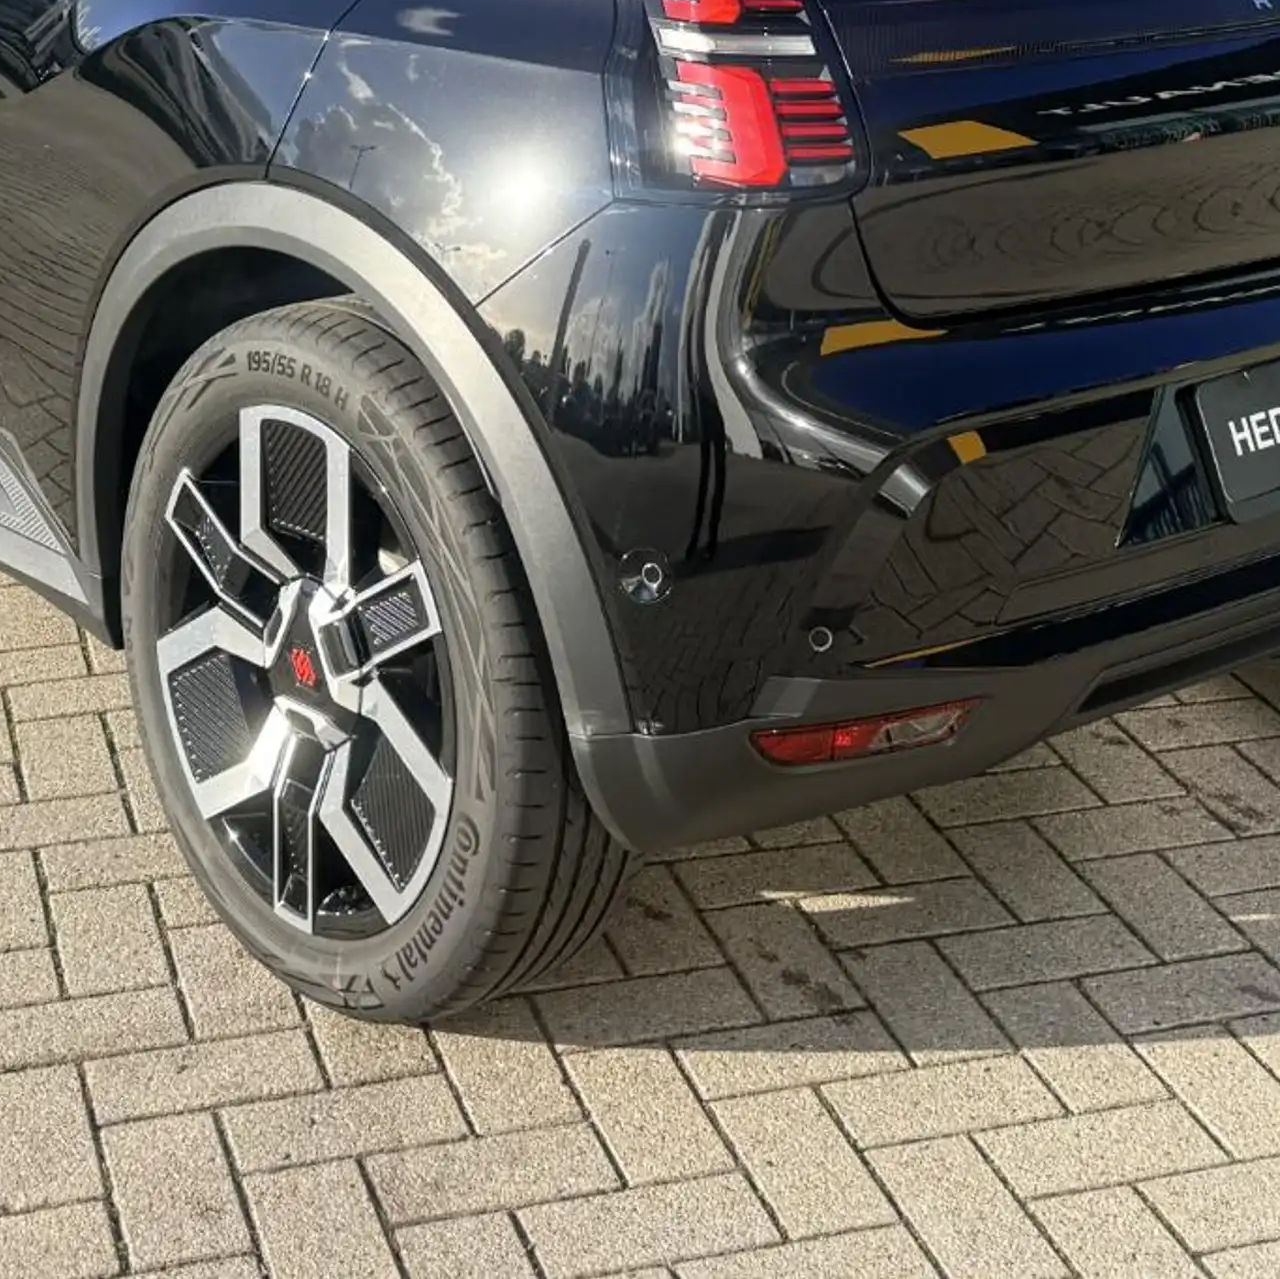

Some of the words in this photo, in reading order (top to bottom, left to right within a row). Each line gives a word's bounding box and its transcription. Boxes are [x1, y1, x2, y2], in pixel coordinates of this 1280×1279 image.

[247, 350, 297, 379] 195/55
[300, 364, 312, 387] R
[315, 371, 332, 398] 18
[334, 386, 350, 411] H
[394, 811, 480, 983] Continental
